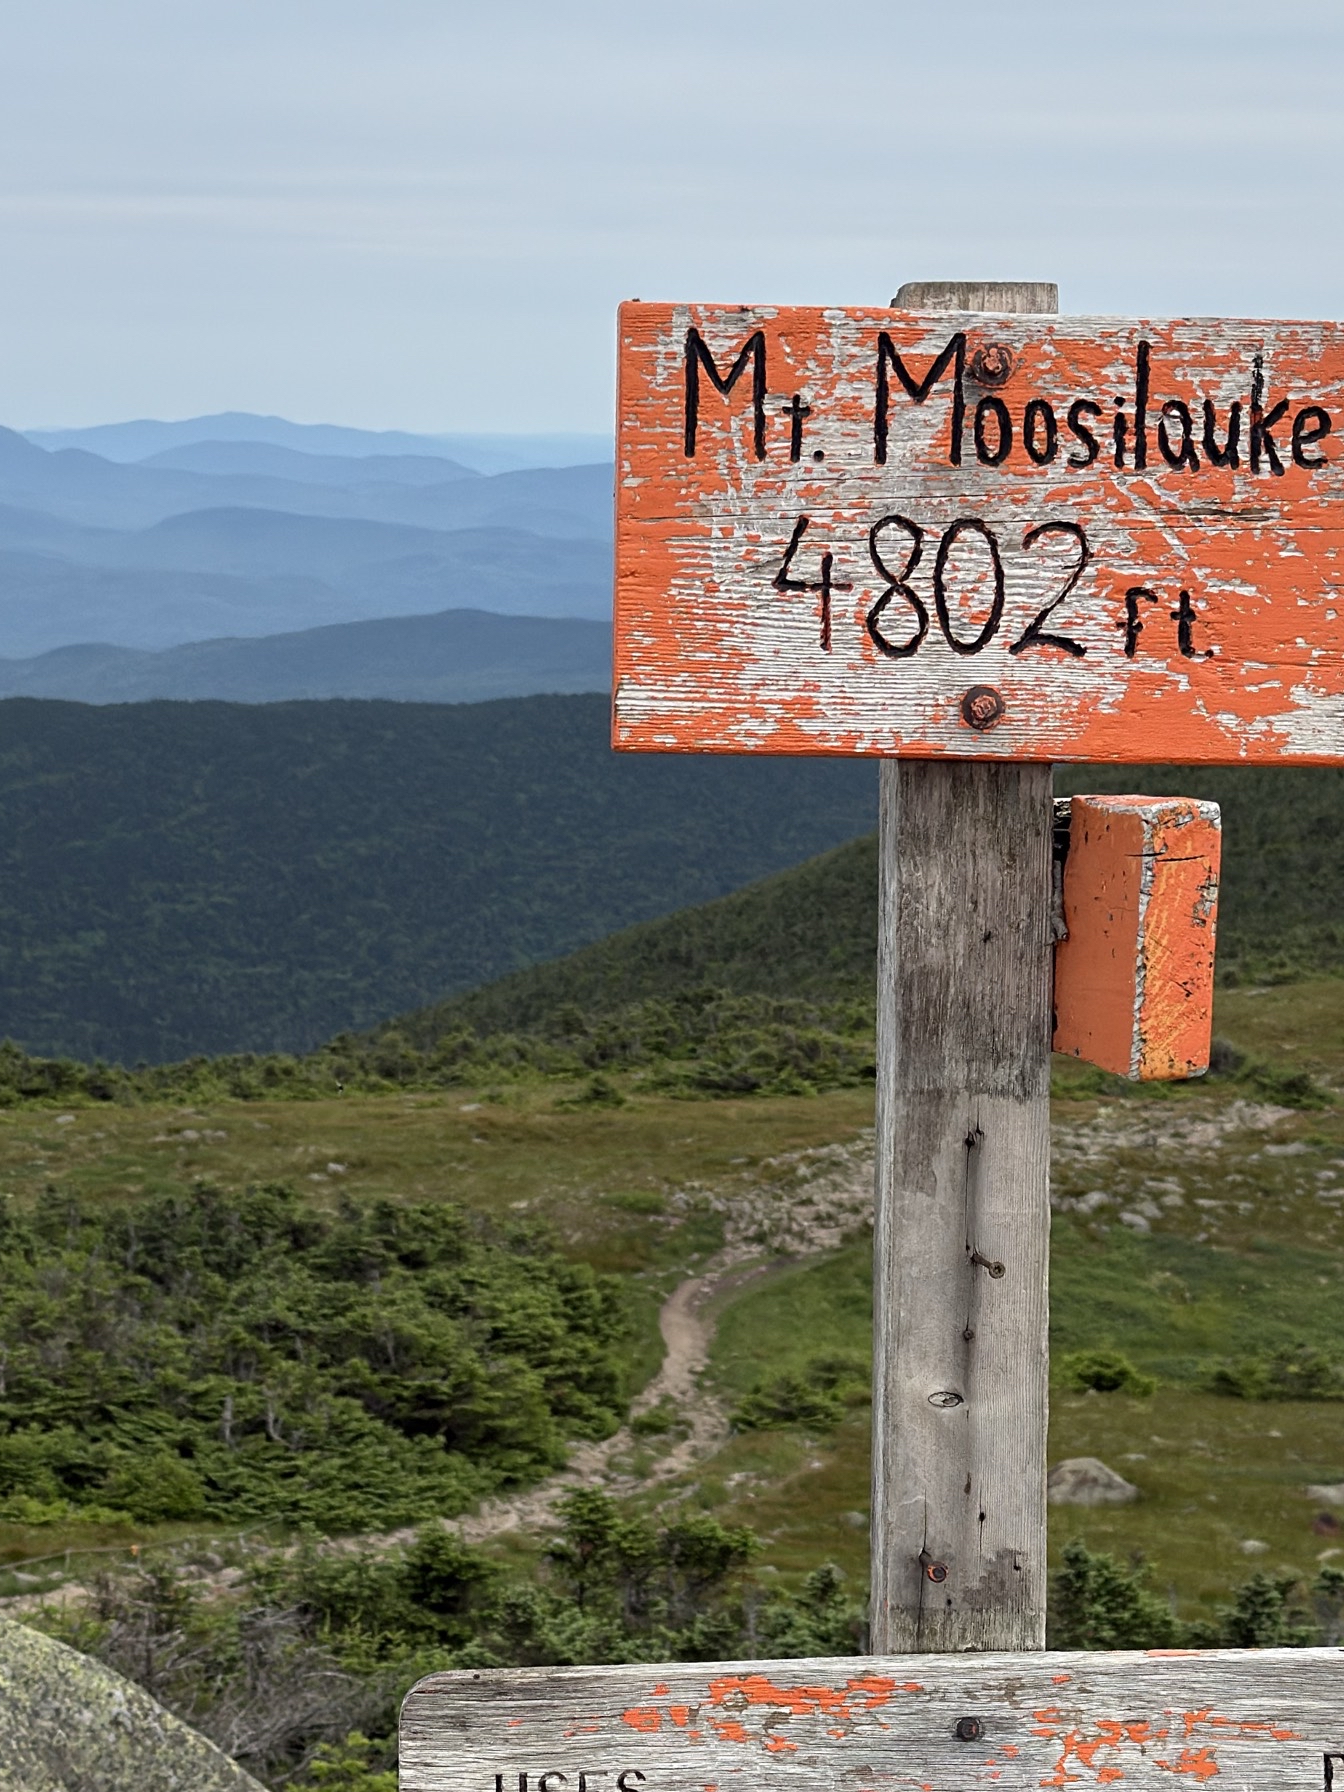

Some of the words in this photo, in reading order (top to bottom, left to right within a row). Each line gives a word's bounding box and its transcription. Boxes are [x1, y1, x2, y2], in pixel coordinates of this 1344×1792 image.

[685, 327, 825, 464] Mt.
[874, 332, 1332, 476] Moosilauke
[771, 515, 1095, 657] 4802
[1116, 586, 1213, 659] ft
